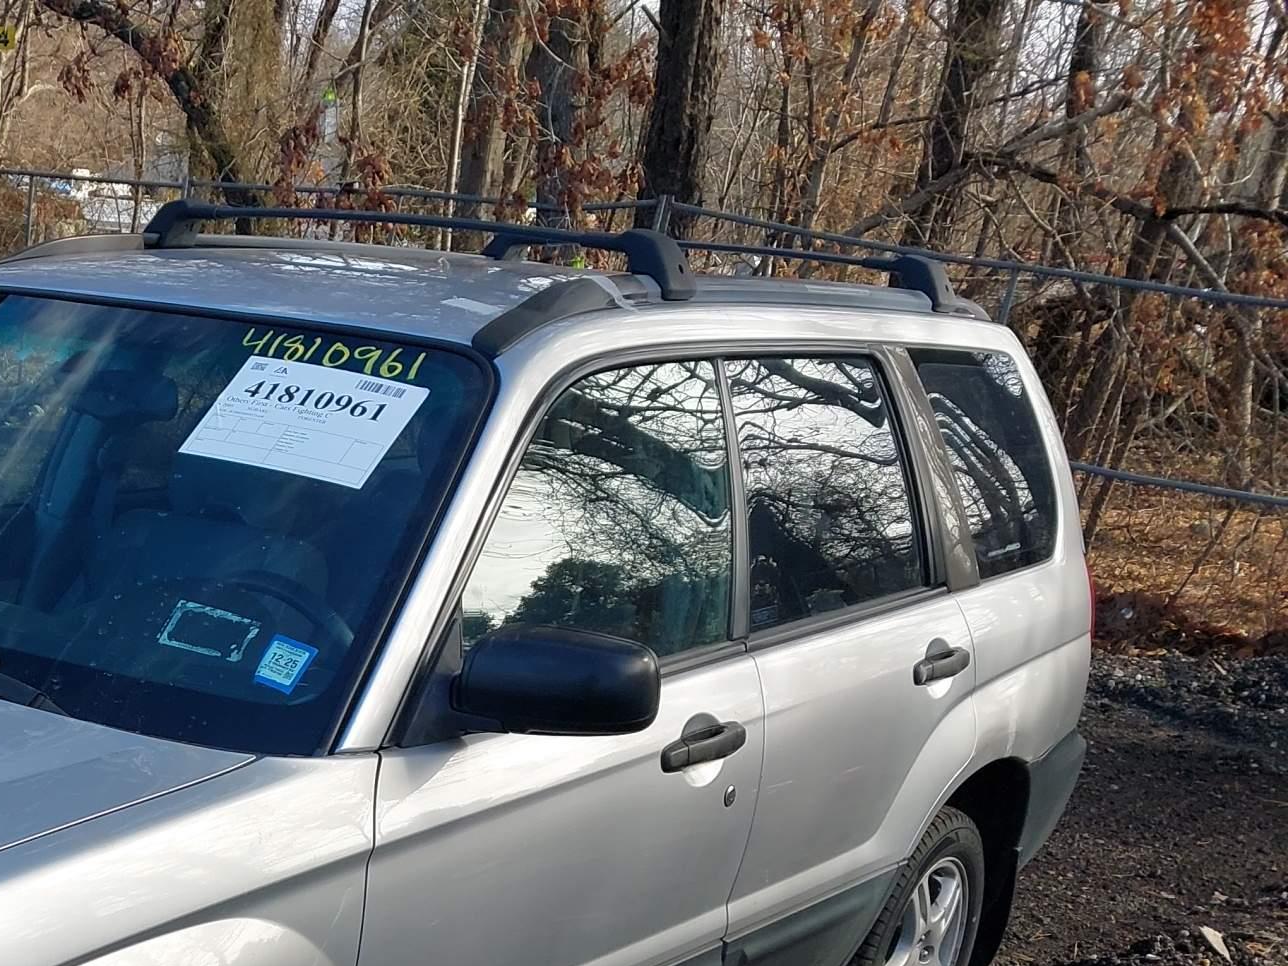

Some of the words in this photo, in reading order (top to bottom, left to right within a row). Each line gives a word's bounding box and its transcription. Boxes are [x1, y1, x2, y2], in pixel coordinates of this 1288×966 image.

[242, 327, 426, 381] 41810961
[244, 379, 387, 422] 41810961
[292, 404, 323, 419] Fighting
[271, 652, 284, 663] 12
[284, 657, 300, 669] 25
